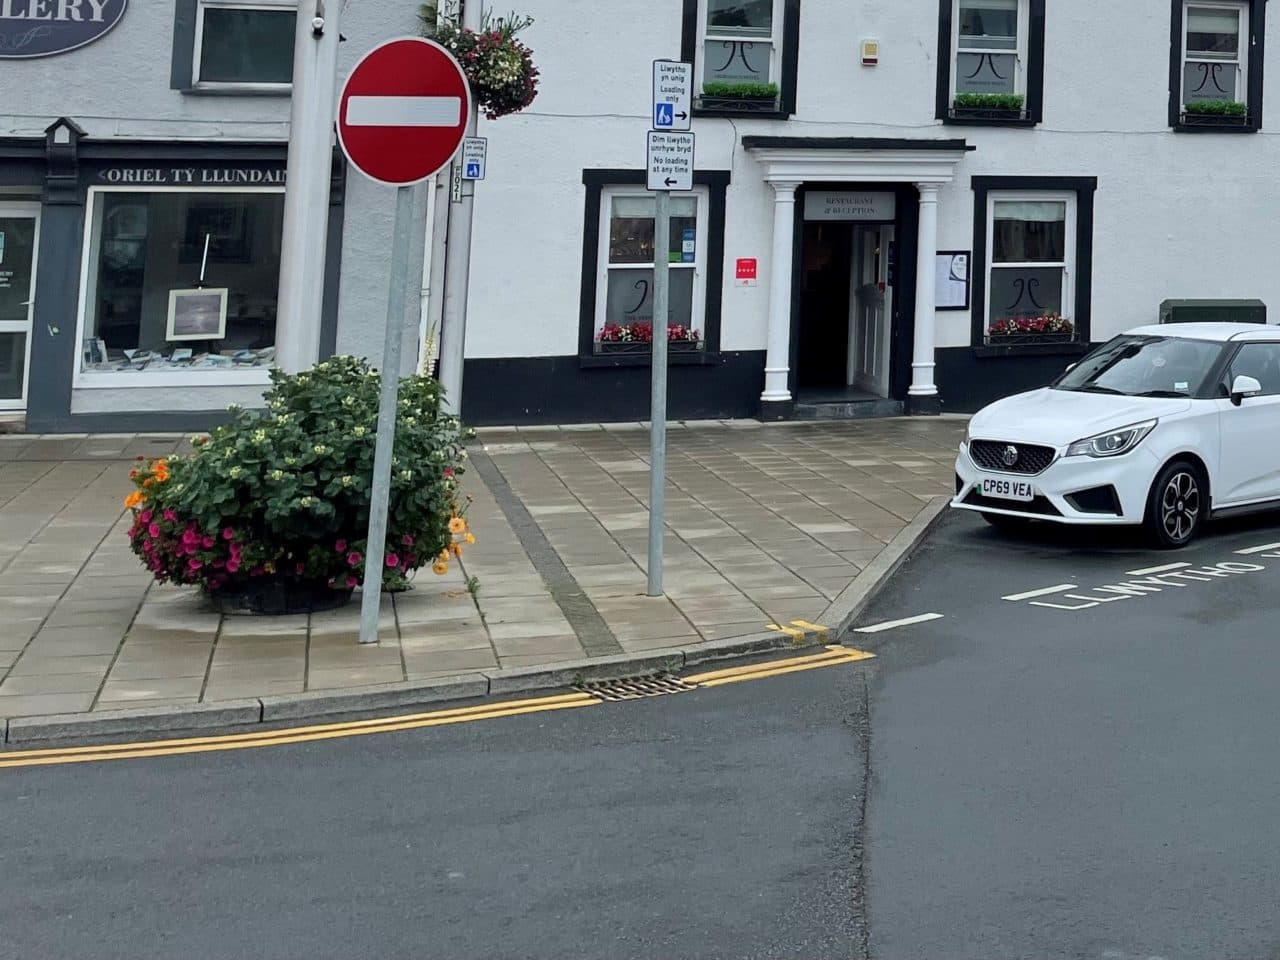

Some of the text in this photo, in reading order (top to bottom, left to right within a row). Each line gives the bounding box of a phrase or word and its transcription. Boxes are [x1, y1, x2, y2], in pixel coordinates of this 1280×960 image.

[671, 75, 685, 83] unig
[660, 85, 685, 95] Loading
[665, 157, 688, 165] loading
[107, 169, 166, 182] ORIEL
[983, 479, 1032, 497] CP69 VEA
[1028, 561, 1266, 610] LLWYTHO
